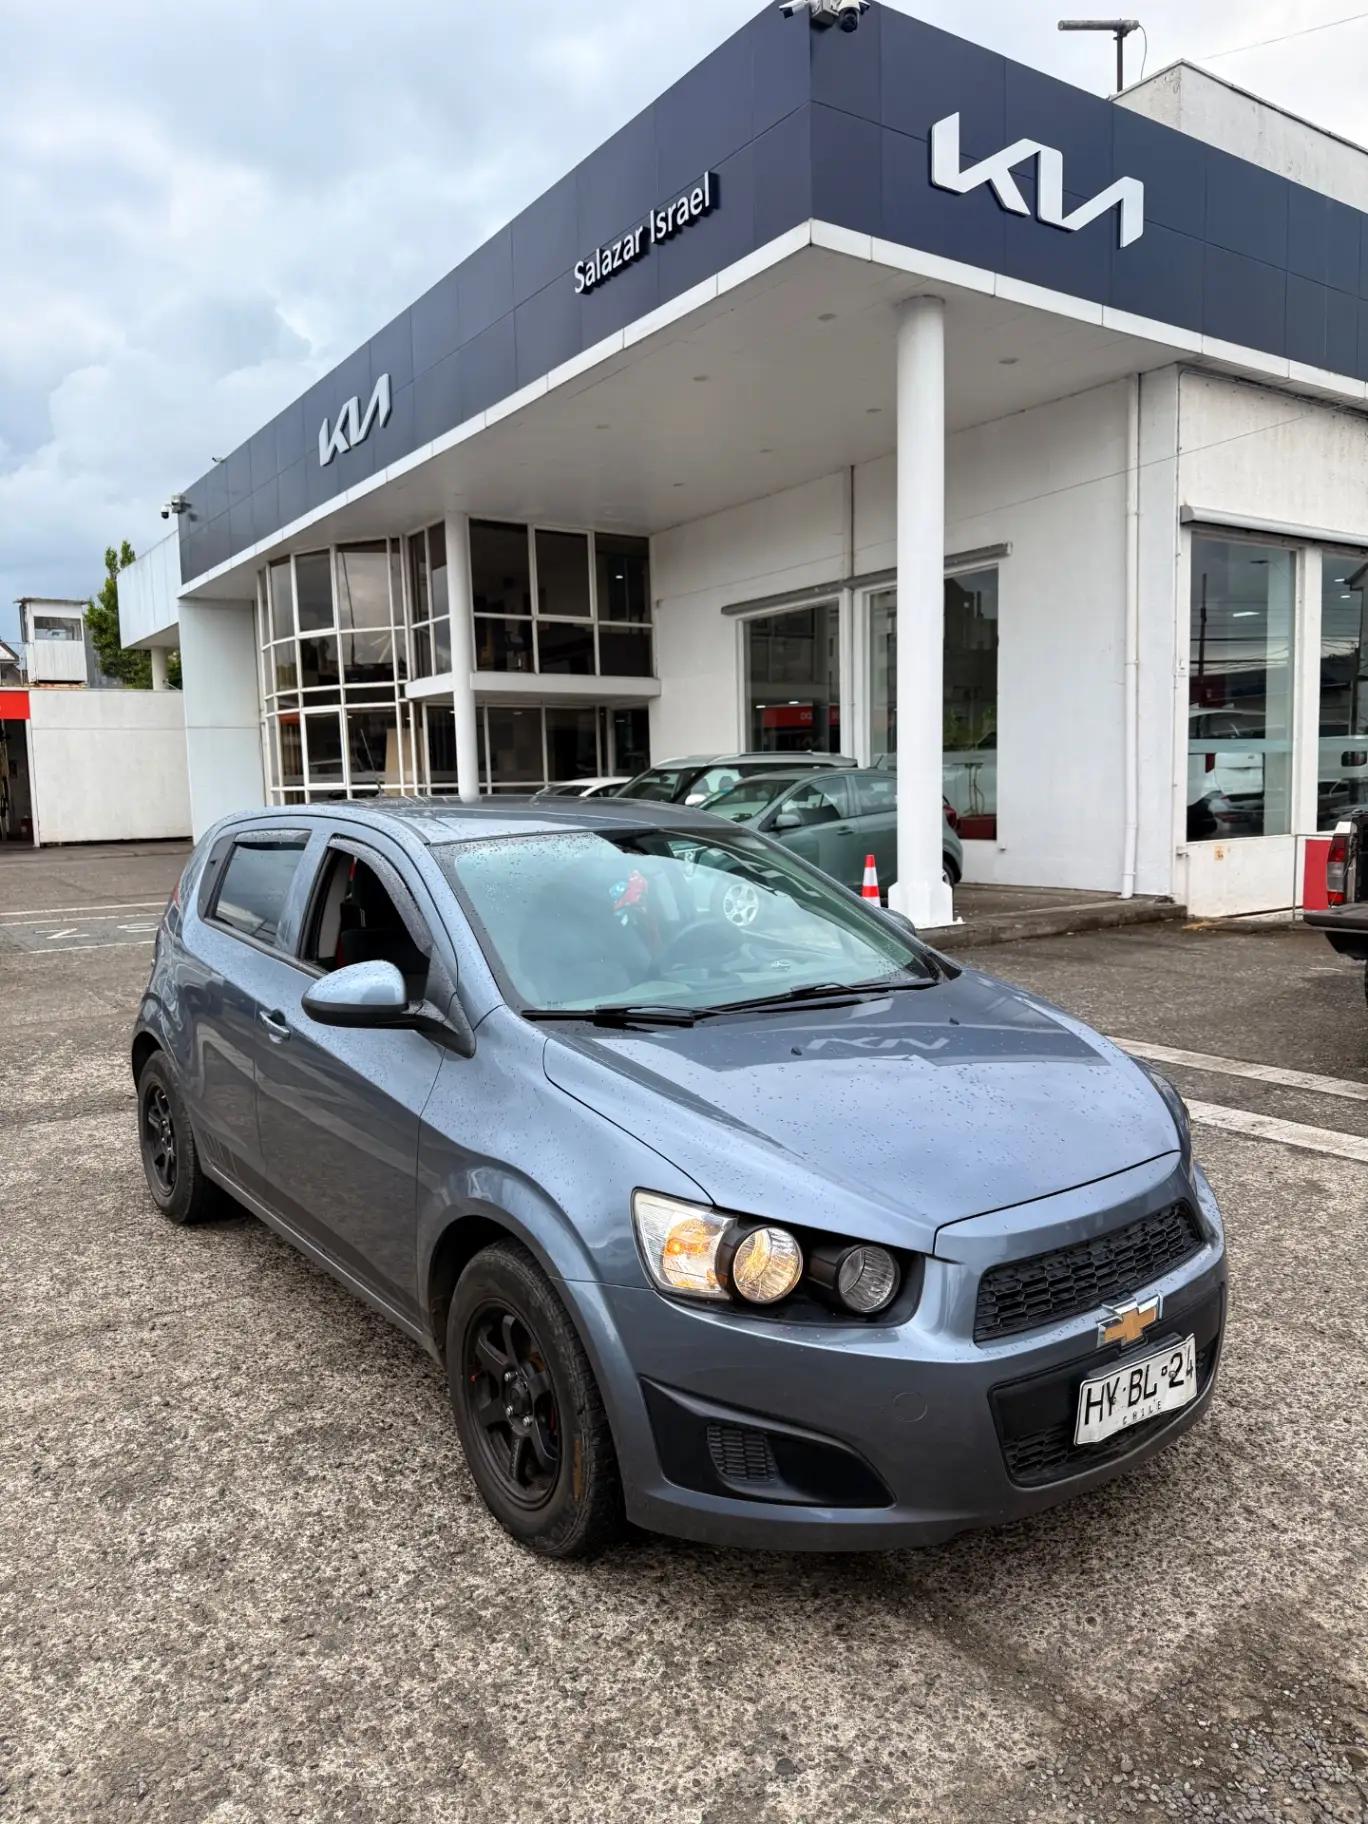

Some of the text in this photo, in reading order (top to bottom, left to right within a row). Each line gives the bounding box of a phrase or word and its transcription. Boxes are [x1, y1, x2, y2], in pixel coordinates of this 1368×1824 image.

[574, 171, 710, 293] Salazar Israel
[931, 111, 1145, 248] KIA
[318, 372, 390, 467] KIA
[1122, 1400, 1162, 1425] CHILE
